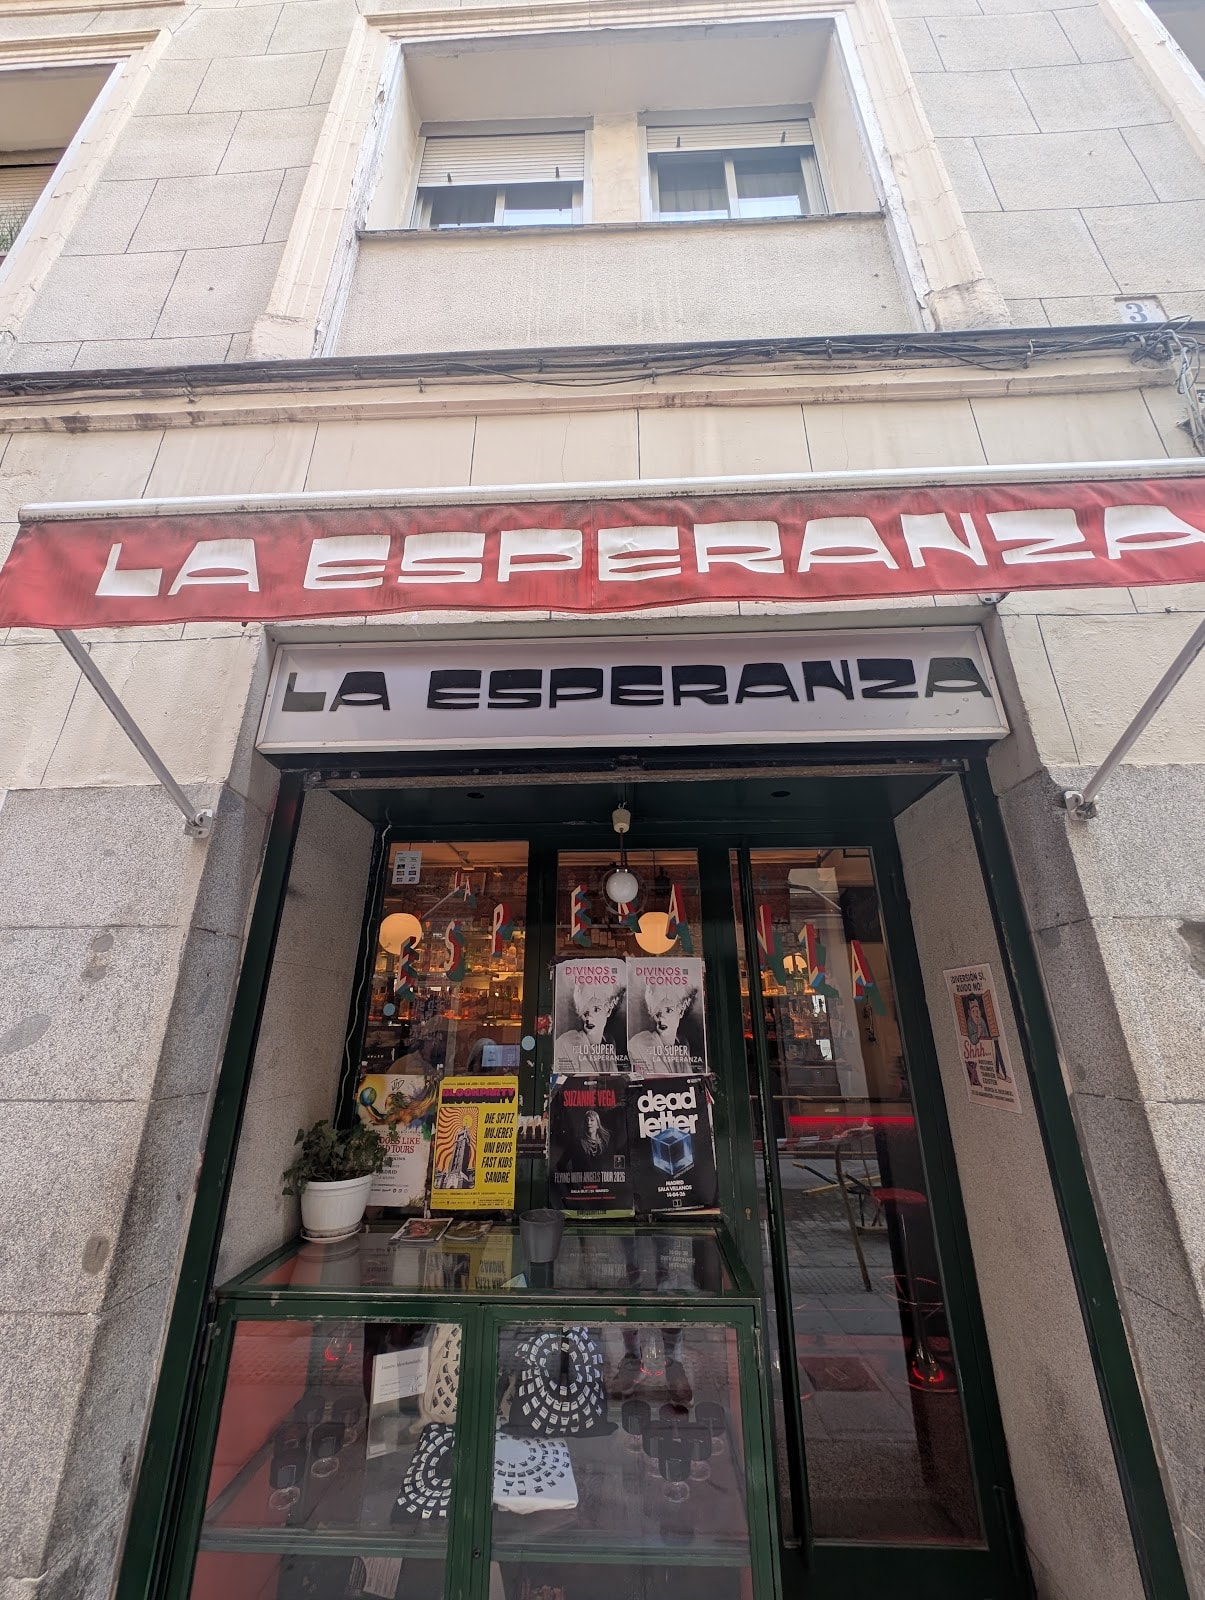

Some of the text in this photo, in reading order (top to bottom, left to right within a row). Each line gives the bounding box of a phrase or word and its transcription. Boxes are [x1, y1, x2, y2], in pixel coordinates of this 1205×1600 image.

[1125, 302, 1148, 322] 3
[95, 504, 1205, 597] LA ESPERANZA
[282, 656, 992, 712] LA ESPERANZA
[565, 966, 610, 976] DIVINOS
[635, 966, 681, 976] DIVINOS
[574, 975, 617, 984] ICONOS
[645, 976, 688, 985] ICONOS
[579, 1044, 589, 1055] LO
[591, 1043, 615, 1054] SUPER
[653, 1045, 688, 1056] LO SUPER
[589, 1054, 629, 1062] ESPERANZA
[563, 1089, 617, 1107] SUZANNE VEGA
[637, 1086, 697, 1113] dead
[484, 1112, 515, 1124] DIE SPITZ
[638, 1110, 699, 1139] letter
[483, 1127, 514, 1139] MUJERES
[401, 1137, 421, 1145] LIKE
[391, 1144, 415, 1154] TOURS
[495, 1142, 513, 1153] BOYS
[481, 1157, 513, 1168] FAST KIDS
[601, 1171, 613, 1183] TOUR
[613, 1171, 626, 1183] 2026
